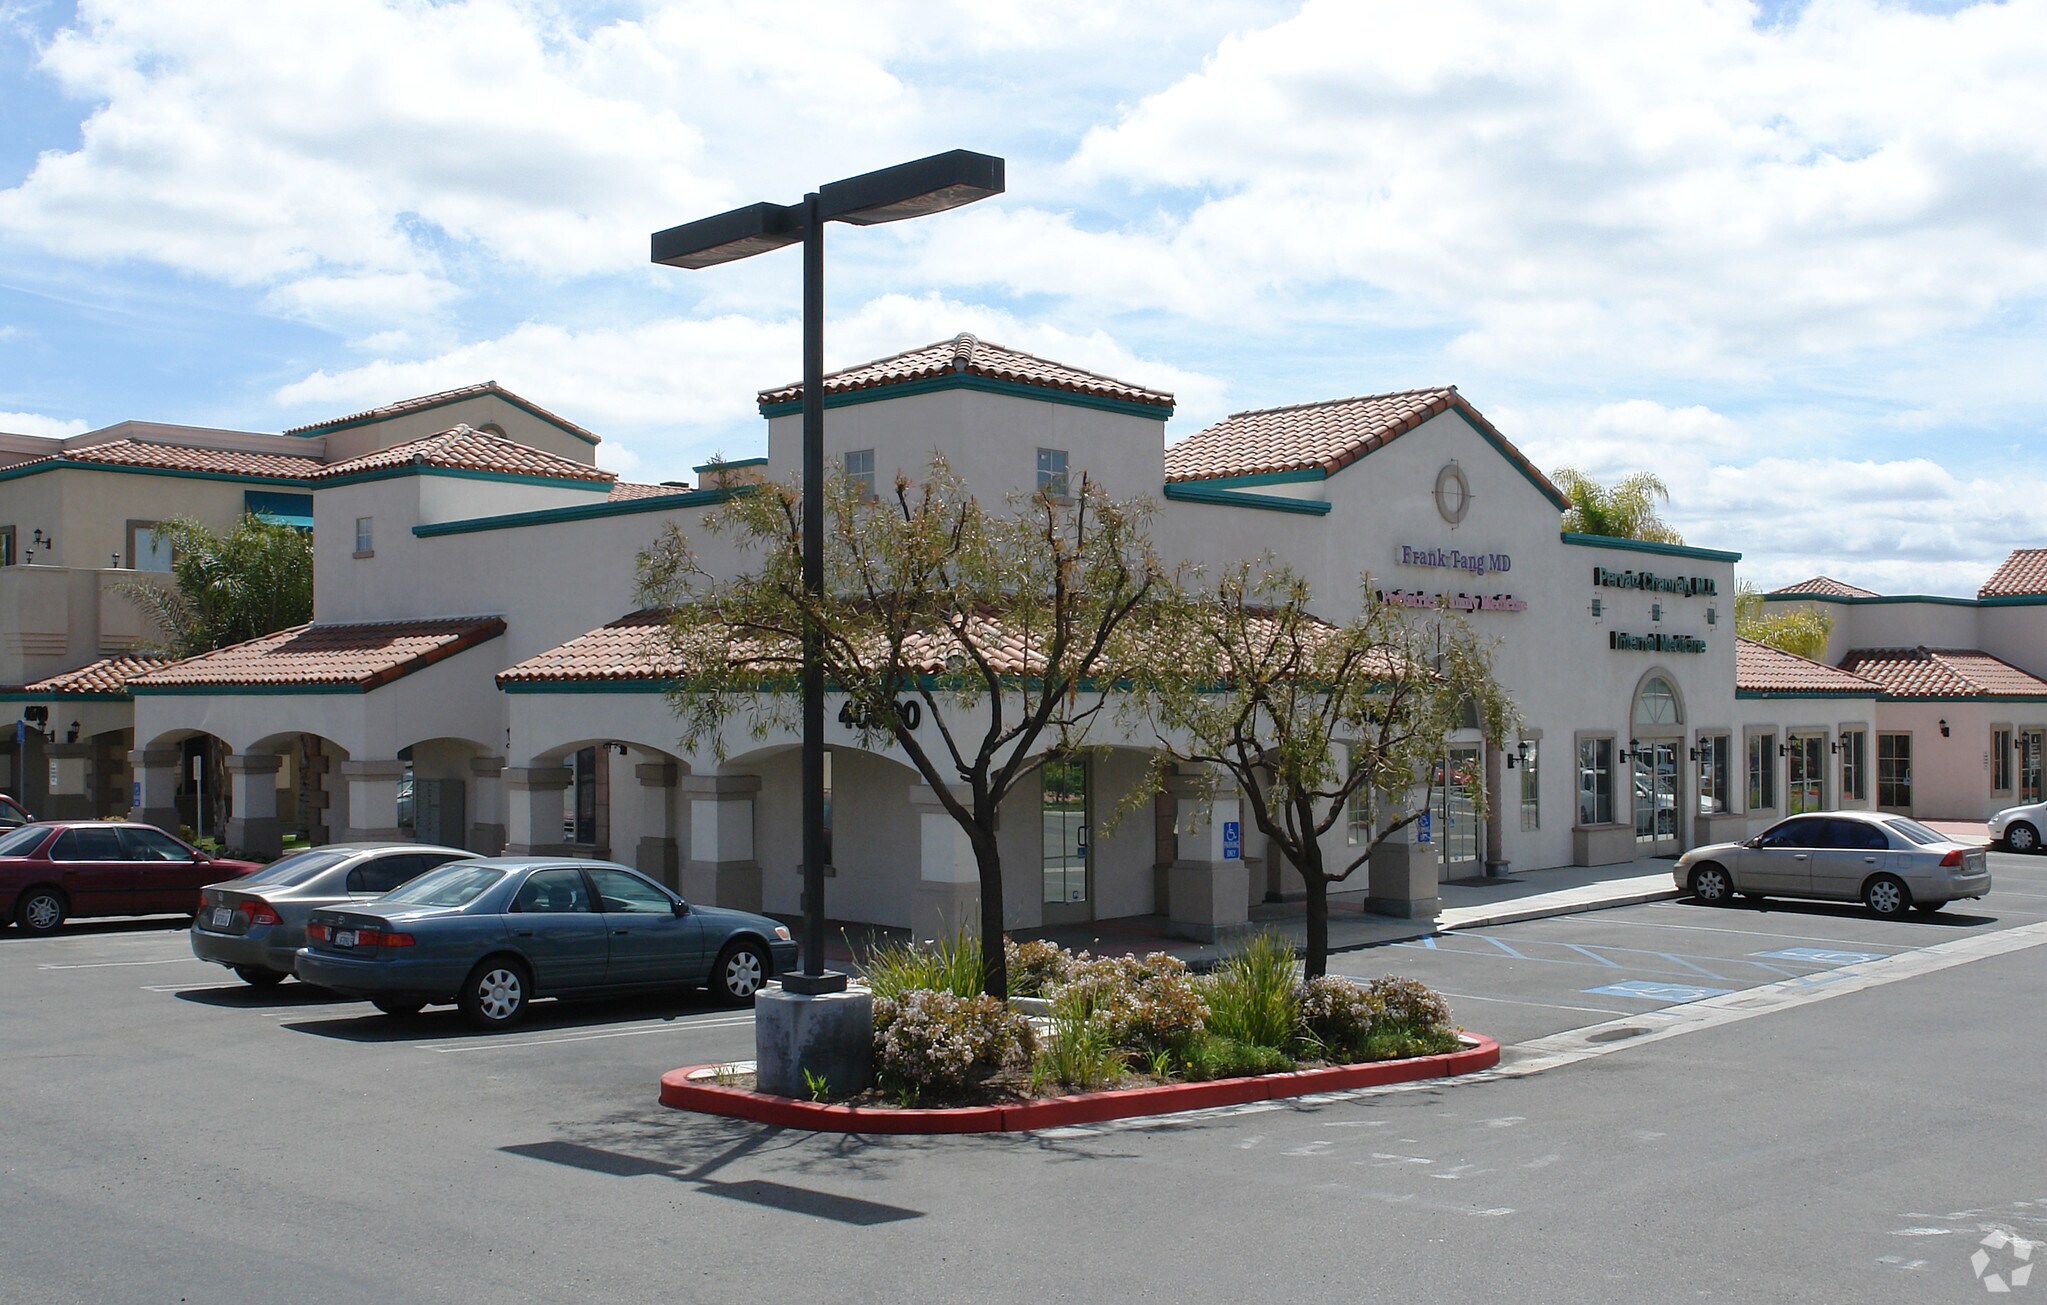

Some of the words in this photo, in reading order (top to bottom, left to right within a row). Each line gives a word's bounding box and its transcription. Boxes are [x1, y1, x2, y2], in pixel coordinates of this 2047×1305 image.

[1402, 545, 1446, 567] Frank
[1450, 550, 1485, 576] Tang
[1489, 554, 1511, 572] MD
[1610, 631, 1657, 652] Internal
[1657, 634, 1707, 654] Medicine
